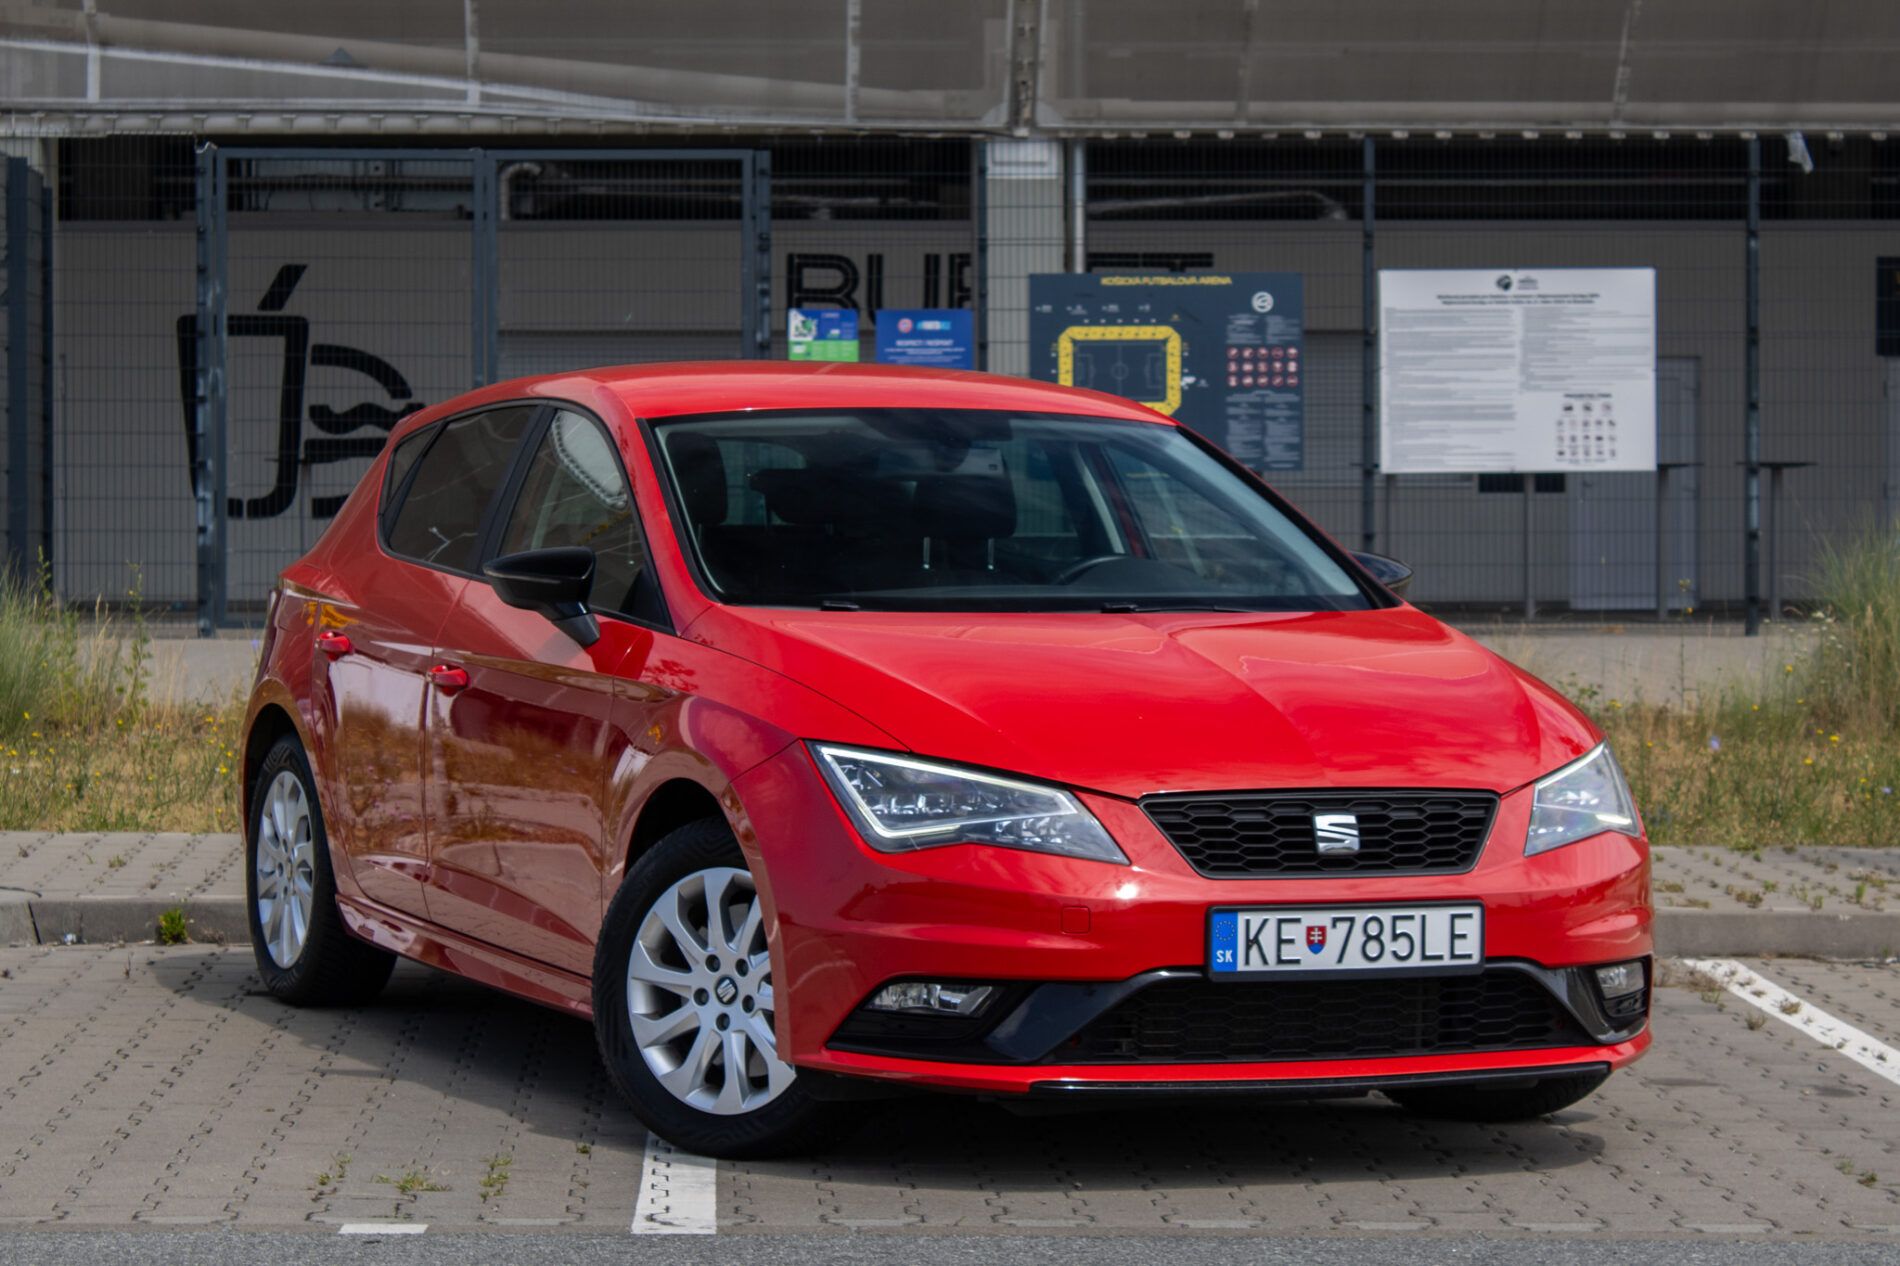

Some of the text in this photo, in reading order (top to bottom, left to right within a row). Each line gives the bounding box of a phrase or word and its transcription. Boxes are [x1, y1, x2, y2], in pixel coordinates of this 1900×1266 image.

[1216, 912, 1474, 966] SK KE 785LE
